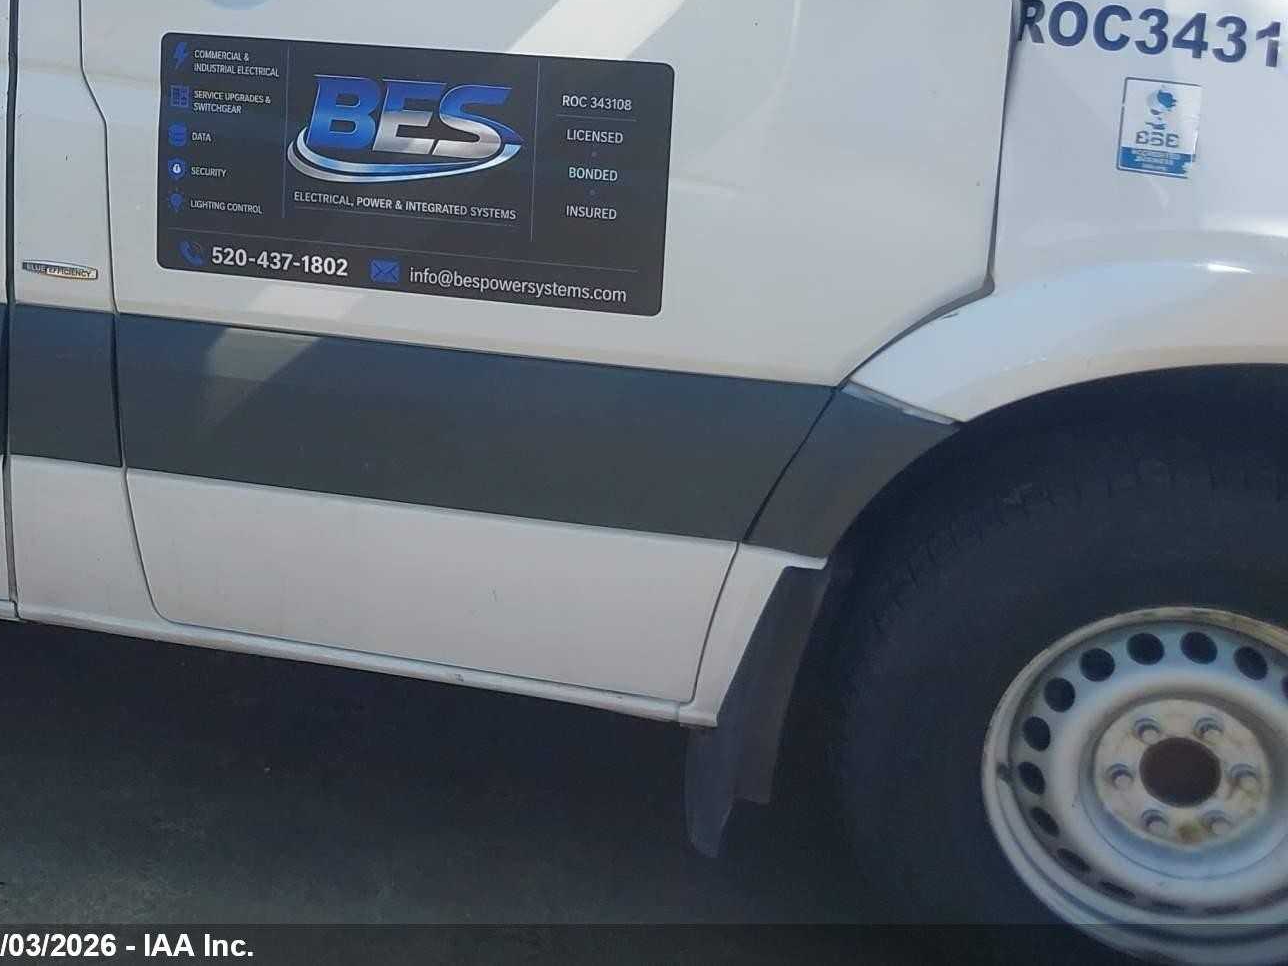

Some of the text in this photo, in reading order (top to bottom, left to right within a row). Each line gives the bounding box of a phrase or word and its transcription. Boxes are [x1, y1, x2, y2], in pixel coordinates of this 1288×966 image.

[1016, 0, 1281, 68] ROC3431
[194, 49, 250, 62] COMMERCIAL &
[193, 63, 280, 78] INDUSTRIAL ELECTRICAL
[193, 90, 271, 104] SERVICE UPGRADES &
[562, 95, 632, 111] ROC 343108
[193, 102, 242, 114] SWITCHGEAR
[307, 74, 524, 160] BES
[192, 132, 211, 142] DATA
[566, 129, 623, 144] LICENSED
[191, 166, 227, 177] SECURITY
[568, 167, 618, 182] BONDED
[190, 200, 263, 215] LIGHTING CONTROL
[294, 191, 517, 220] ELECTRICAL, POWER & INTEGRATED SYSTEMS
[566, 205, 617, 220] INSURED
[211, 246, 349, 277] 520-437-1802
[409, 266, 627, 303] info@bespowersystems.com
